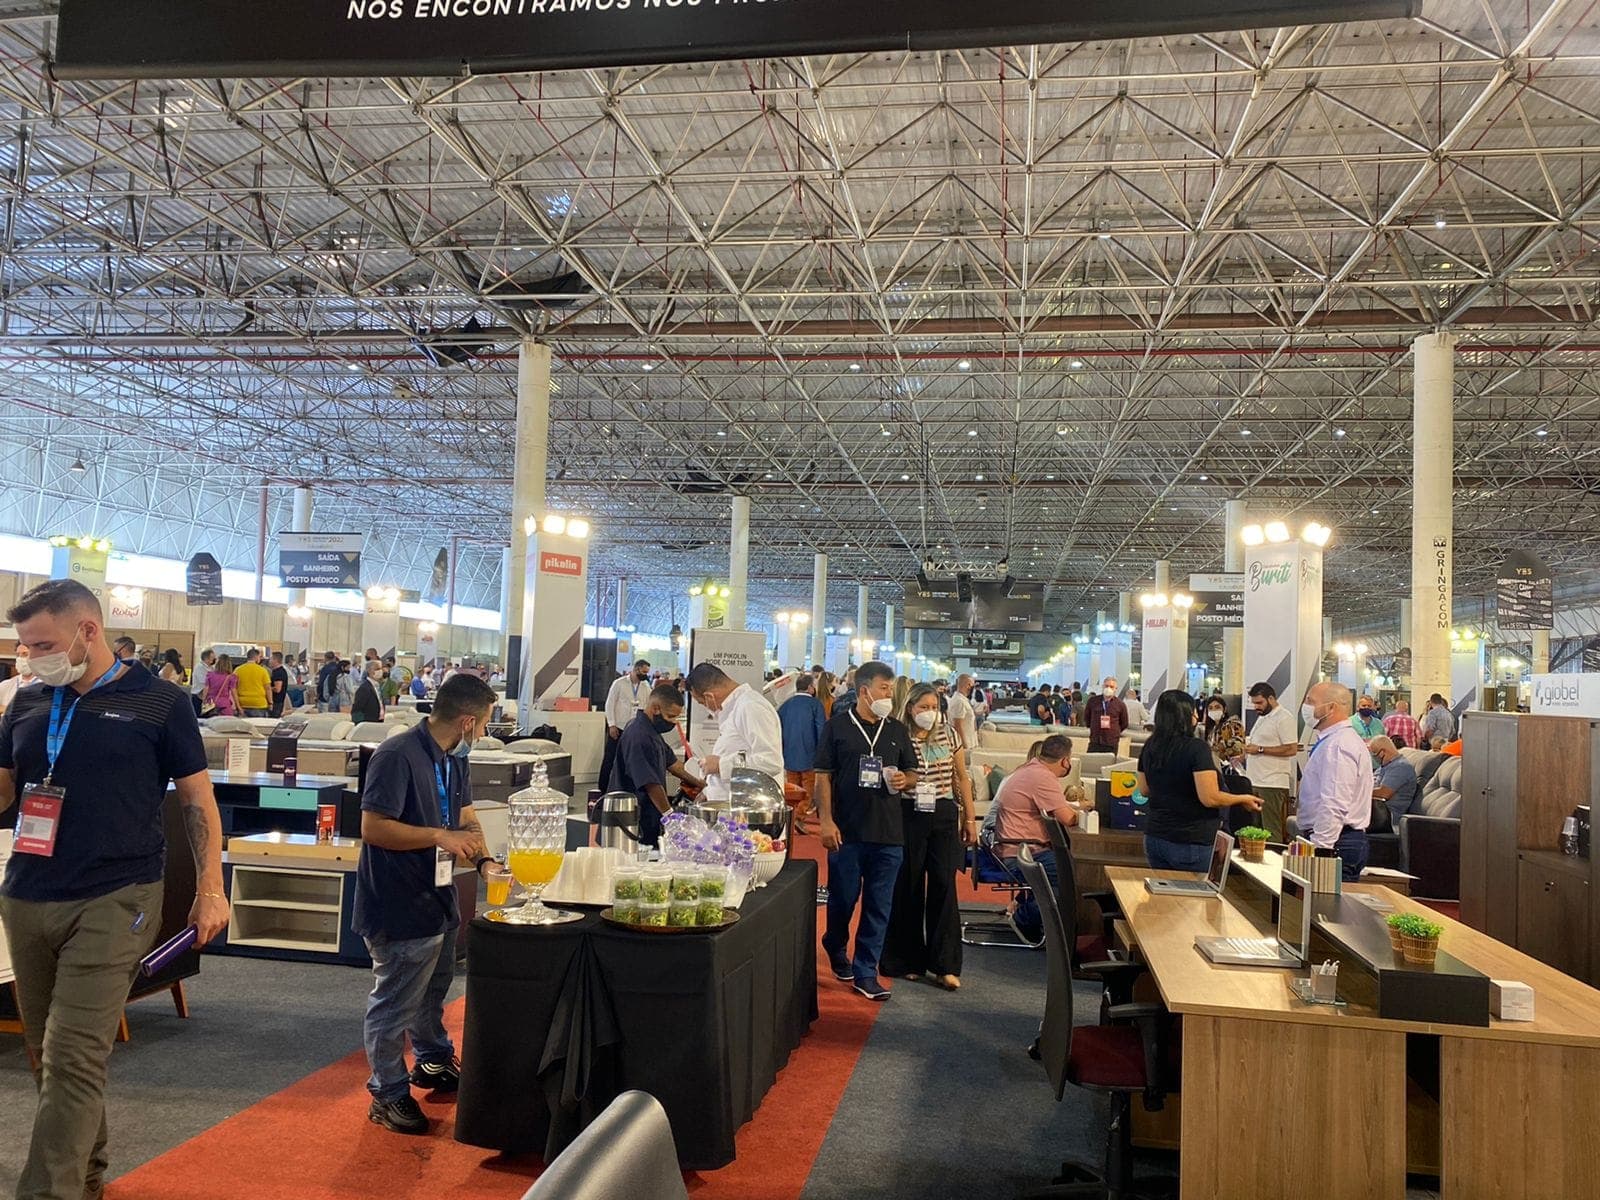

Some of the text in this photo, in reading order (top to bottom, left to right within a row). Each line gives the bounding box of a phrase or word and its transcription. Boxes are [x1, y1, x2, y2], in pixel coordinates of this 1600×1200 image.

[347, 0, 402, 19] NOS
[318, 553, 340, 561] SAÍDA
[303, 564, 340, 572] BANHEIRO
[545, 557, 577, 570] pikolin
[285, 575, 340, 584] POSTO MÉDICO
[1436, 550, 1449, 628] GRINGA.COM
[1224, 613, 1244, 622] MÉD
[723, 652, 747, 660] PIKOLIN
